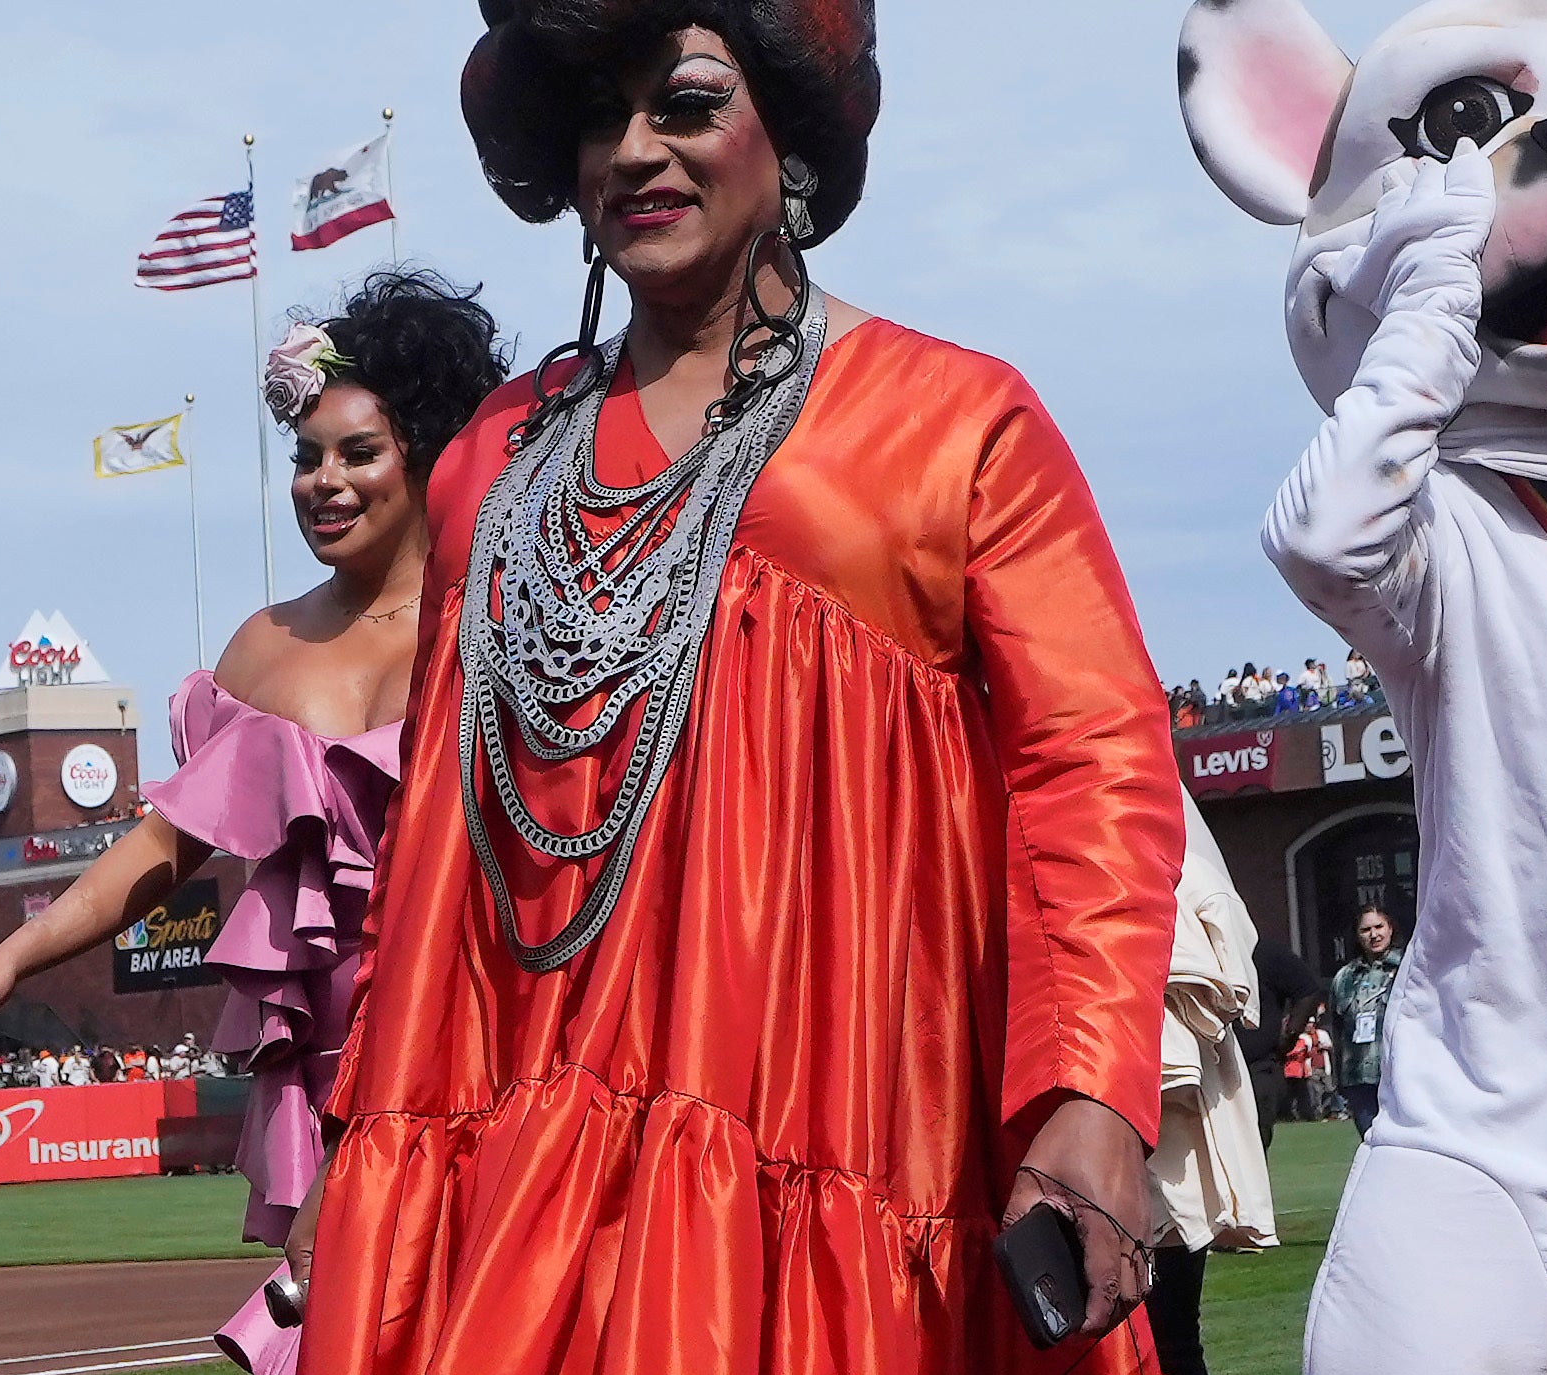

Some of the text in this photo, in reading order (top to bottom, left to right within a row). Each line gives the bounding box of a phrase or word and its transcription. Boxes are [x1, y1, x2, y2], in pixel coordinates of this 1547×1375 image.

[8, 639, 82, 668] Coors
[69, 763, 109, 782] Coors
[74, 780, 106, 790] LIGHT
[145, 905, 217, 951] Sports
[130, 946, 202, 974] BAY AREA
